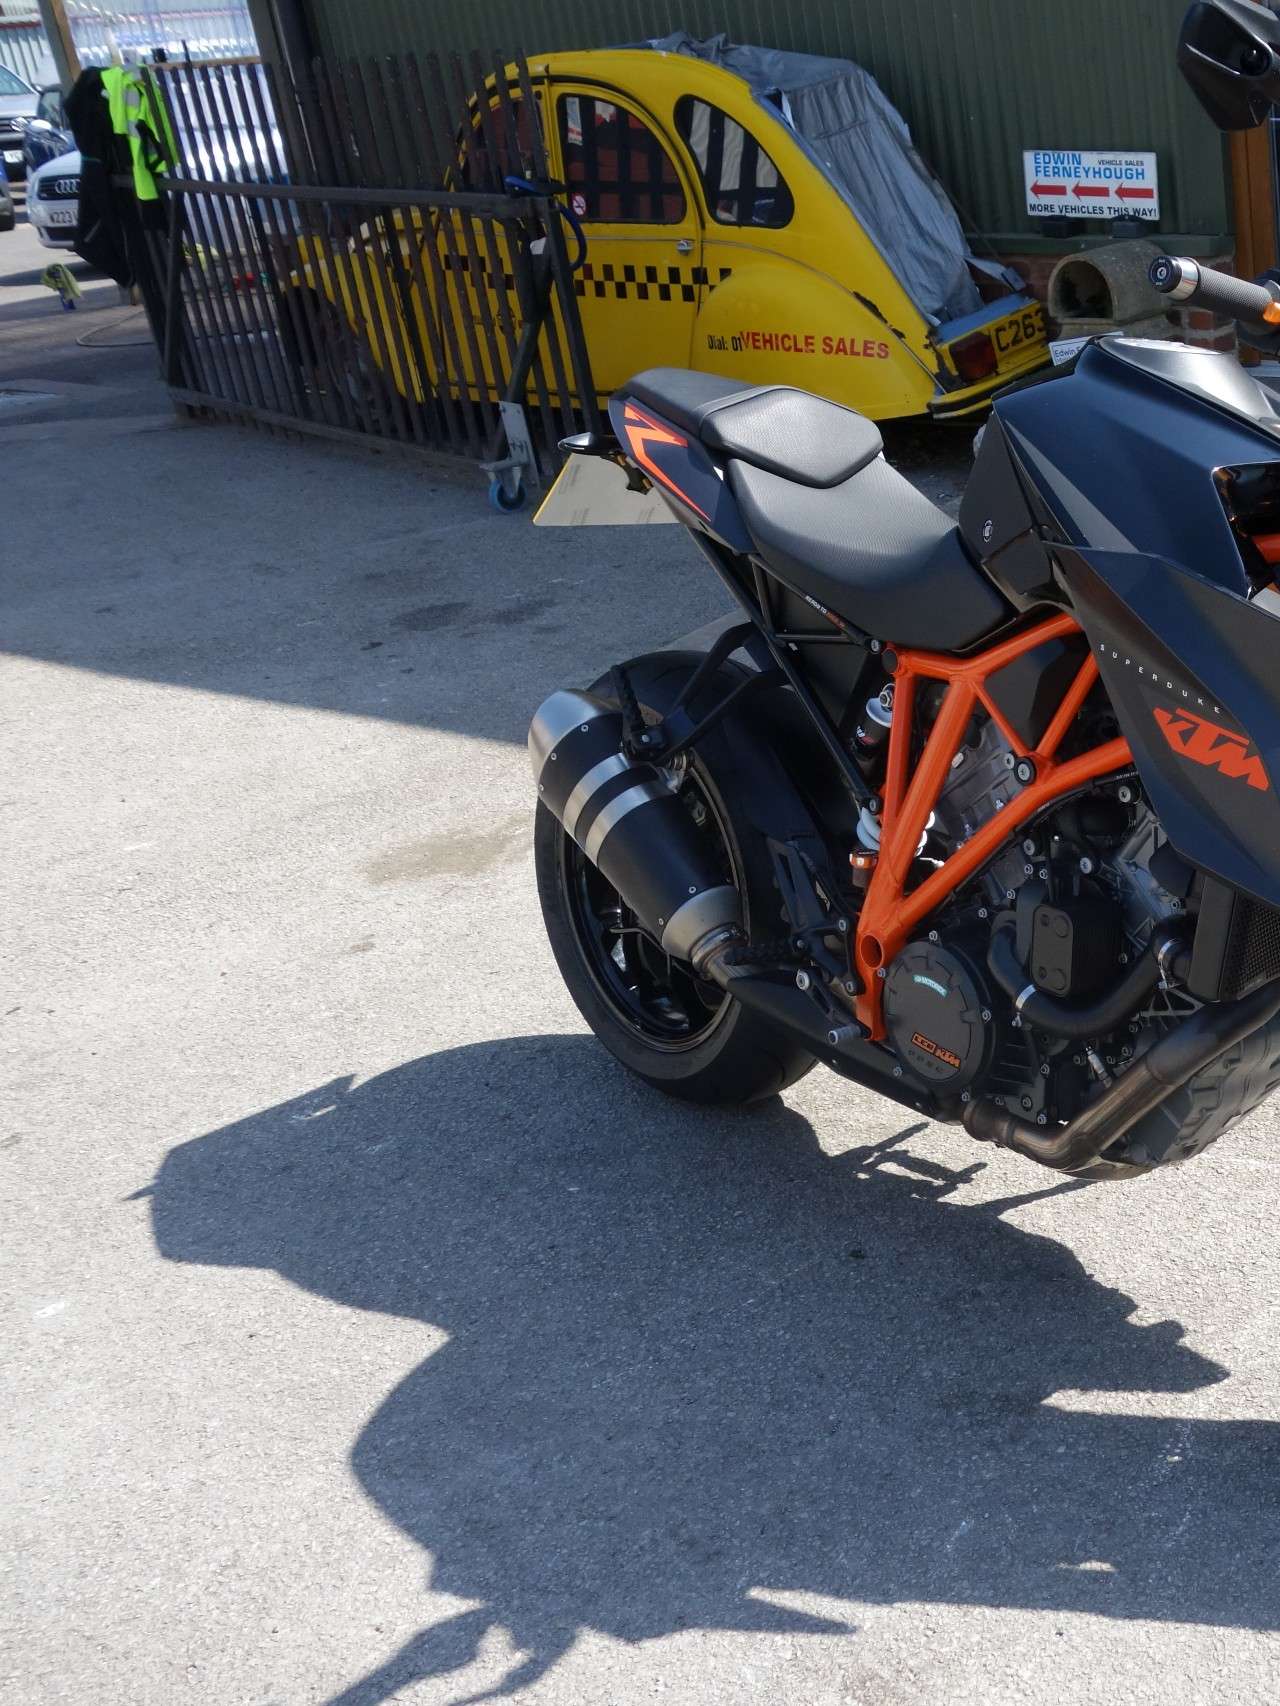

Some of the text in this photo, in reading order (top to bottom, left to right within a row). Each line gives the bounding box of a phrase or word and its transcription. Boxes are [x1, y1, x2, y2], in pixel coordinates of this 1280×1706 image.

[1033, 152, 1082, 165] EDWIN
[1034, 166, 1145, 180] FERNEYHOUGH
[1029, 203, 1157, 217] MORE VEHICLES THIS WAY!
[740, 331, 889, 360] VEHICLE SALES
[1152, 707, 1270, 792] KTM
